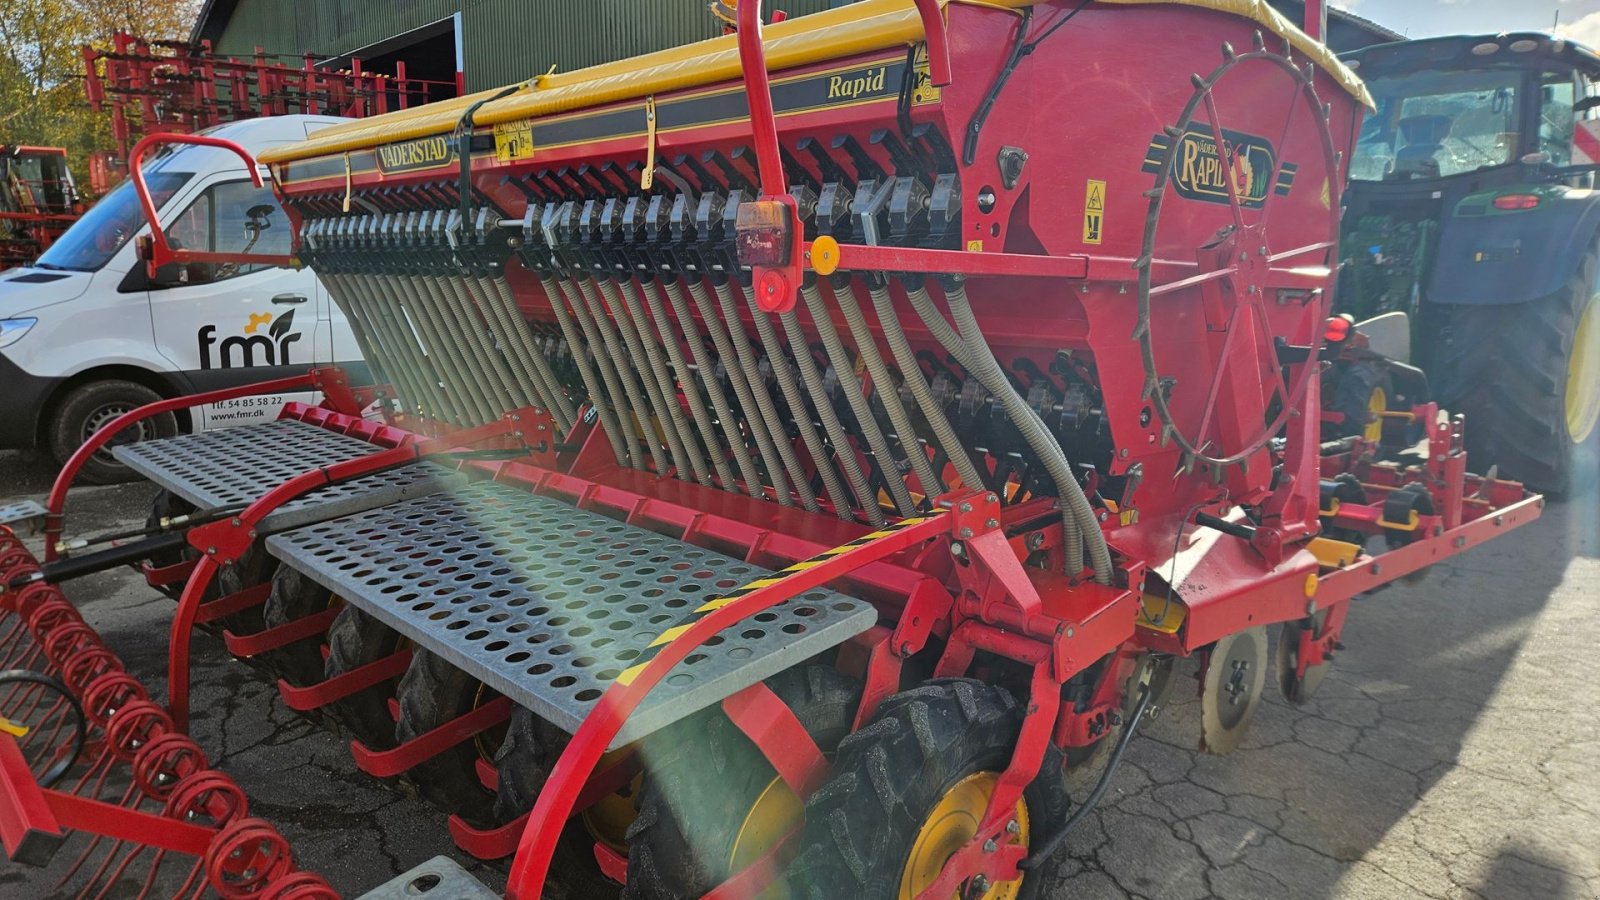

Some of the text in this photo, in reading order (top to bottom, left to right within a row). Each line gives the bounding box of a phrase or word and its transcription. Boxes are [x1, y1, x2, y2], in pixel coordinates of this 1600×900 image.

[828, 67, 886, 99] Rapid
[1197, 139, 1232, 158] VÄDERD
[198, 325, 302, 370] fmr
[212, 396, 283, 410] Tlf. 54 85 58 22
[210, 409, 265, 421] www.fmr.dk
